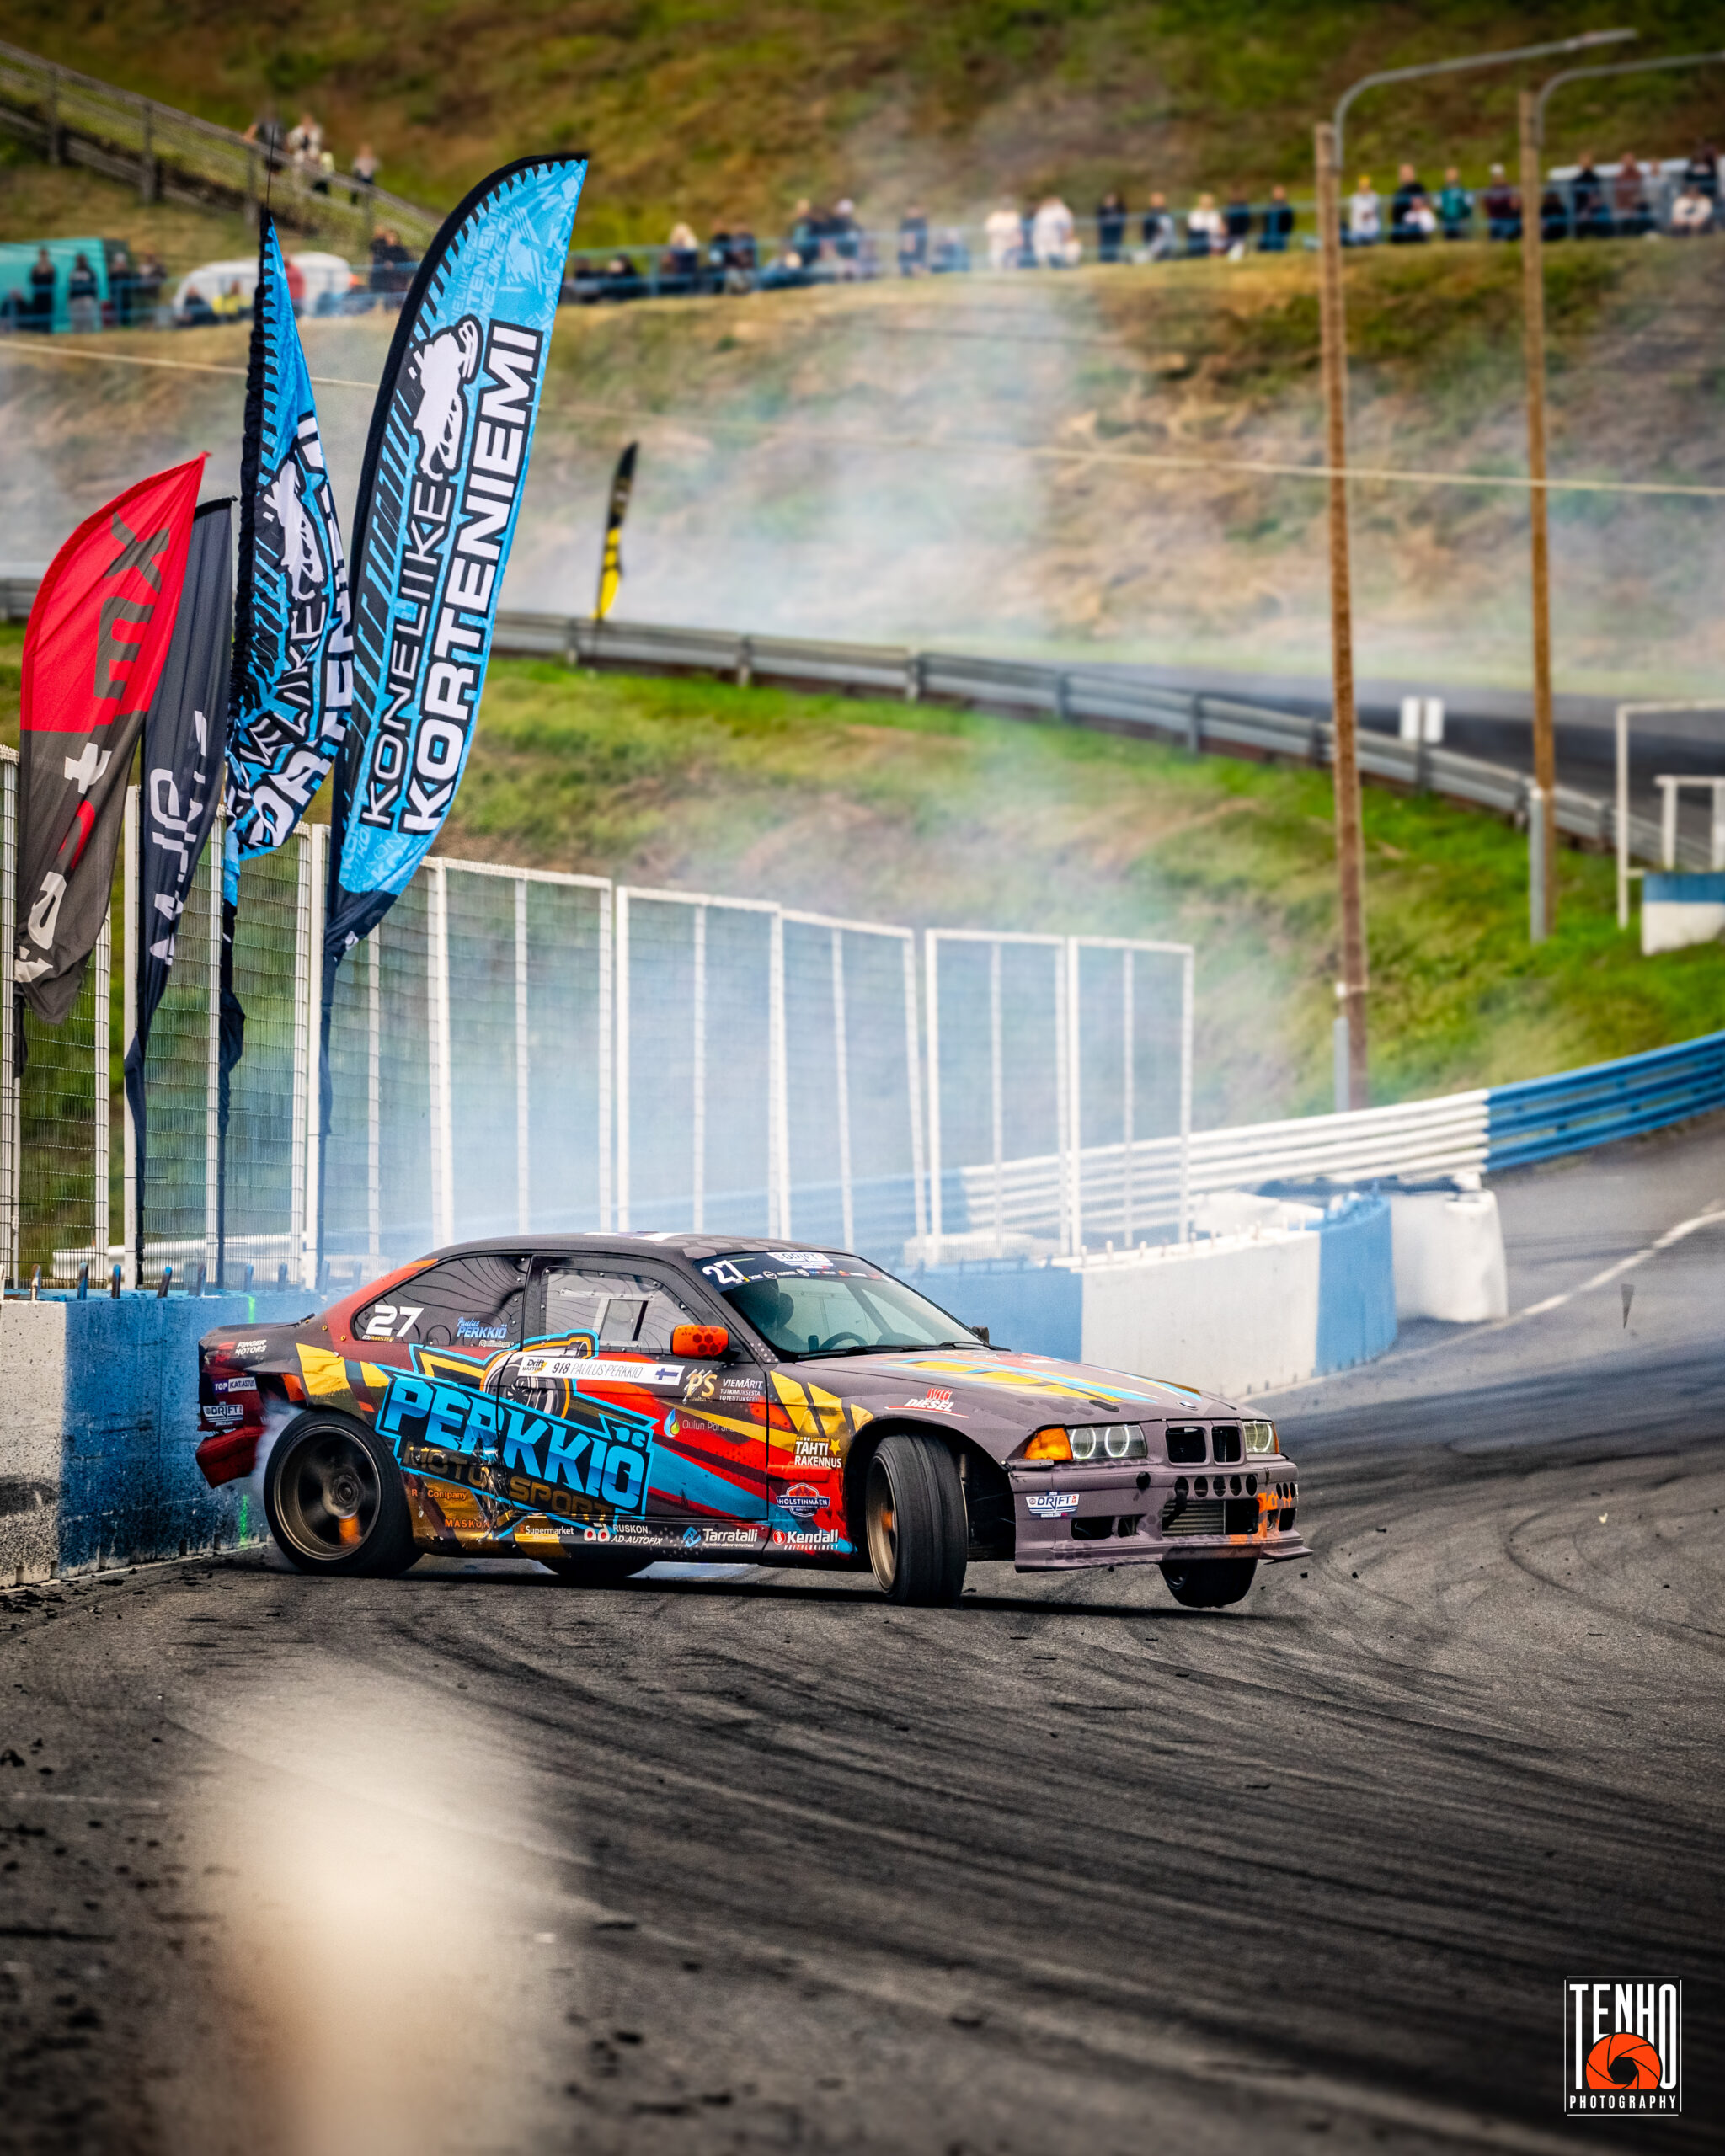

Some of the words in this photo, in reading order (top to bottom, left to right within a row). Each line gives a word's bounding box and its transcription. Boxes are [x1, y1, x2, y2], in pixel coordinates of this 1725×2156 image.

[403, 326, 537, 831] KORTENIEMI
[362, 481, 451, 825] KONELIIKE
[702, 1260, 745, 1284] 27
[366, 1305, 424, 1337] 27
[457, 1324, 507, 1339] PERKKIÖ
[235, 1345, 267, 1355] MOTORS
[237, 1340, 267, 1349] FINGER
[527, 1358, 545, 1367] Drift
[552, 1362, 571, 1374] 918
[571, 1363, 604, 1376] PAULUS
[215, 1382, 227, 1390] TOP
[687, 1374, 718, 1397] PS
[904, 1399, 954, 1412] DIESEL
[211, 1406, 238, 1419] DRIFT
[682, 1419, 704, 1430] Oulun
[383, 1374, 646, 1509] PERKKIÖ
[794, 1456, 842, 1468] RAKENNUS
[427, 1489, 467, 1500] Company
[778, 1497, 828, 1506] HOLSTINMÄEN
[1037, 1496, 1072, 1510] DRIFT
[525, 1525, 574, 1535] Supermarket
[613, 1524, 649, 1534] RUSKON
[702, 1528, 758, 1542] Tarratalli
[611, 1535, 663, 1545] AD-AUTOFIX
[787, 1529, 839, 1543] Kendall
